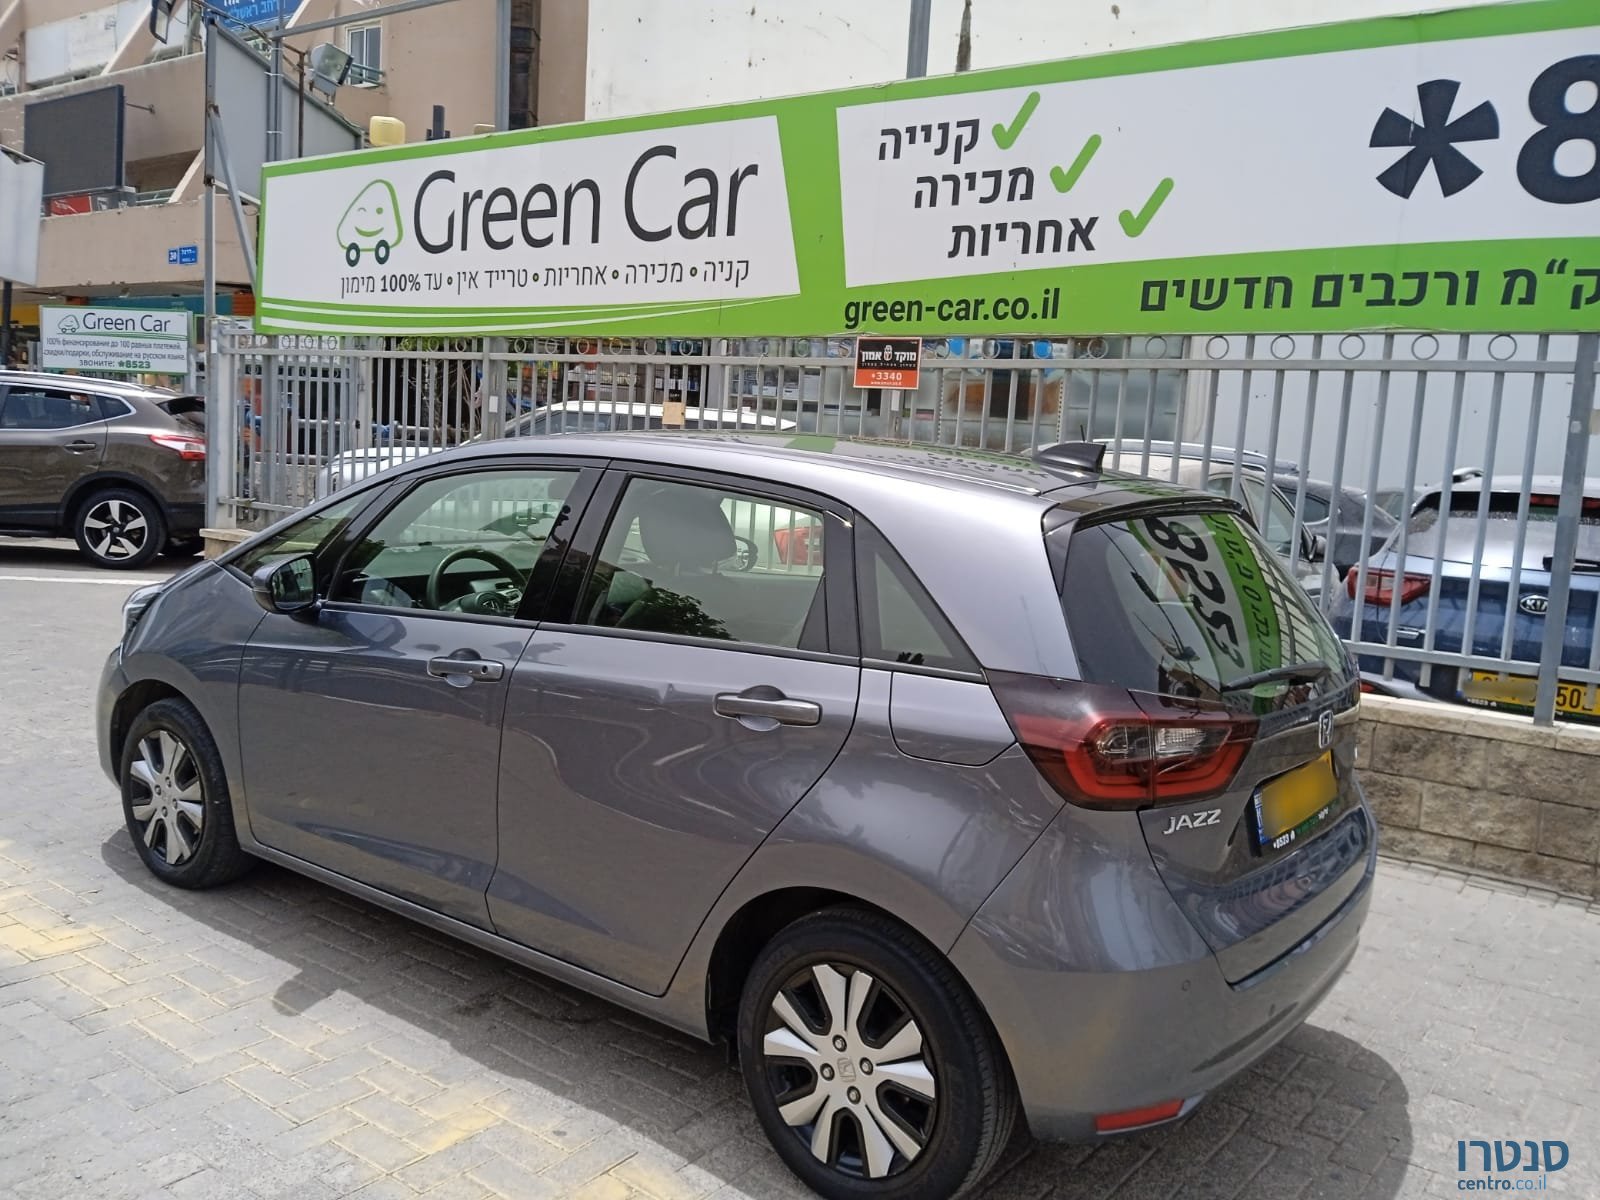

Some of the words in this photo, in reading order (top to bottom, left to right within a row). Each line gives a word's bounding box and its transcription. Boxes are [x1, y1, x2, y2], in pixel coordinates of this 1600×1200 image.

[878, 118, 980, 164] קנייה
[413, 169, 601, 255] Green
[623, 144, 759, 243] Car
[914, 166, 1035, 208] מכירה
[948, 216, 1099, 258] אחריות
[380, 273, 421, 293] 100%
[423, 272, 443, 291] עד
[456, 270, 480, 295] אין
[484, 268, 528, 289] טרייד
[543, 265, 608, 287] אחריות
[625, 262, 683, 285] מכירה
[703, 259, 749, 288] קניה
[341, 275, 375, 299] מימון
[1140, 275, 1293, 312] חדשים
[1312, 270, 1479, 308] ורכבים
[844, 288, 1060, 329] green-car.co.il
[83, 312, 136, 331] Green
[140, 314, 171, 332] Car
[894, 351, 917, 363] מוקד
[1163, 808, 1222, 835] JAZZ
